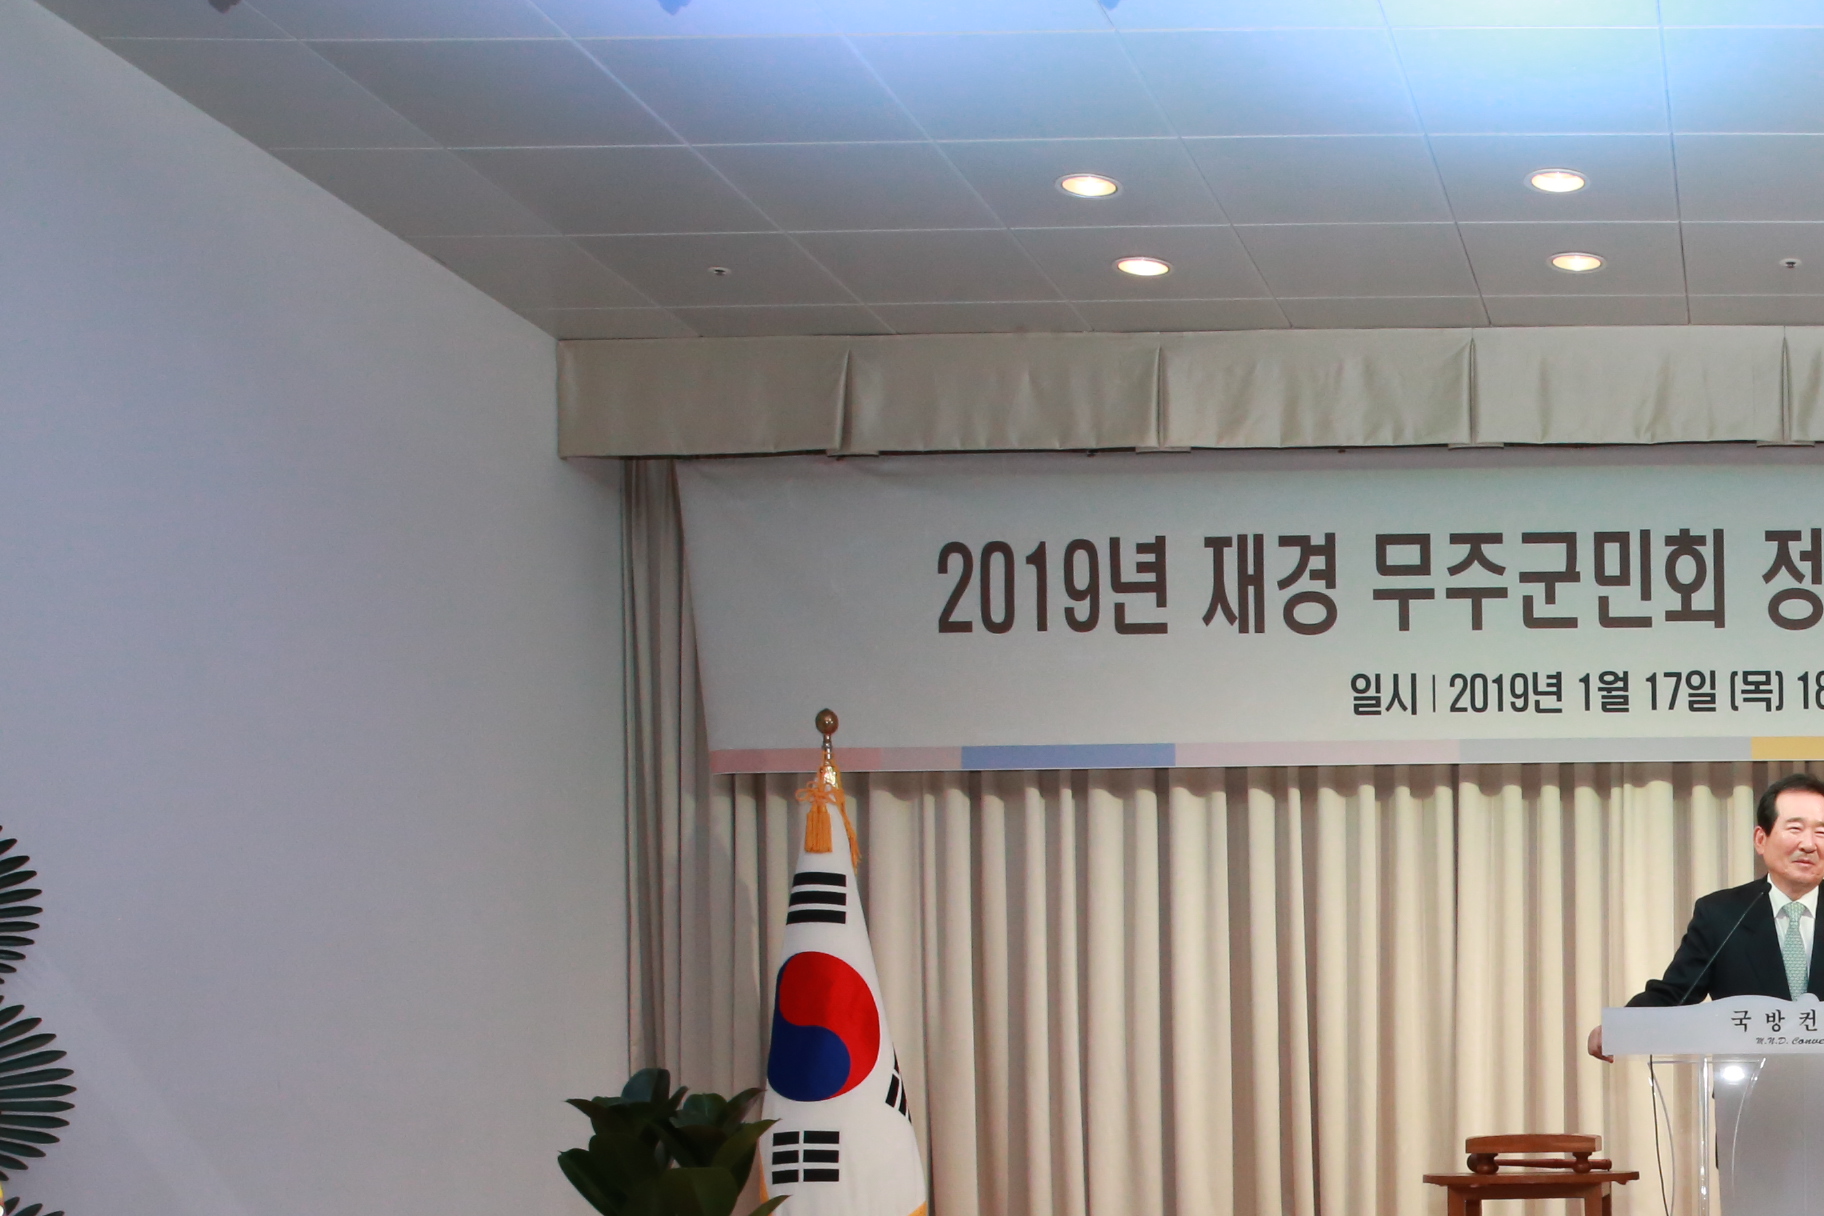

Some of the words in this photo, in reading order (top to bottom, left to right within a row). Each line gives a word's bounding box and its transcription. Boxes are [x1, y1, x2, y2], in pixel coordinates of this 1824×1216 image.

[938, 536, 1168, 634] 2019년
[1202, 533, 1337, 635] 재경
[1373, 529, 1725, 631] 무주군민회
[1351, 673, 1417, 715] 일시
[1450, 672, 1562, 713] 2019년
[1579, 671, 1629, 712] 1월
[1646, 670, 1716, 712] 17일
[1730, 671, 1783, 711] (목)
